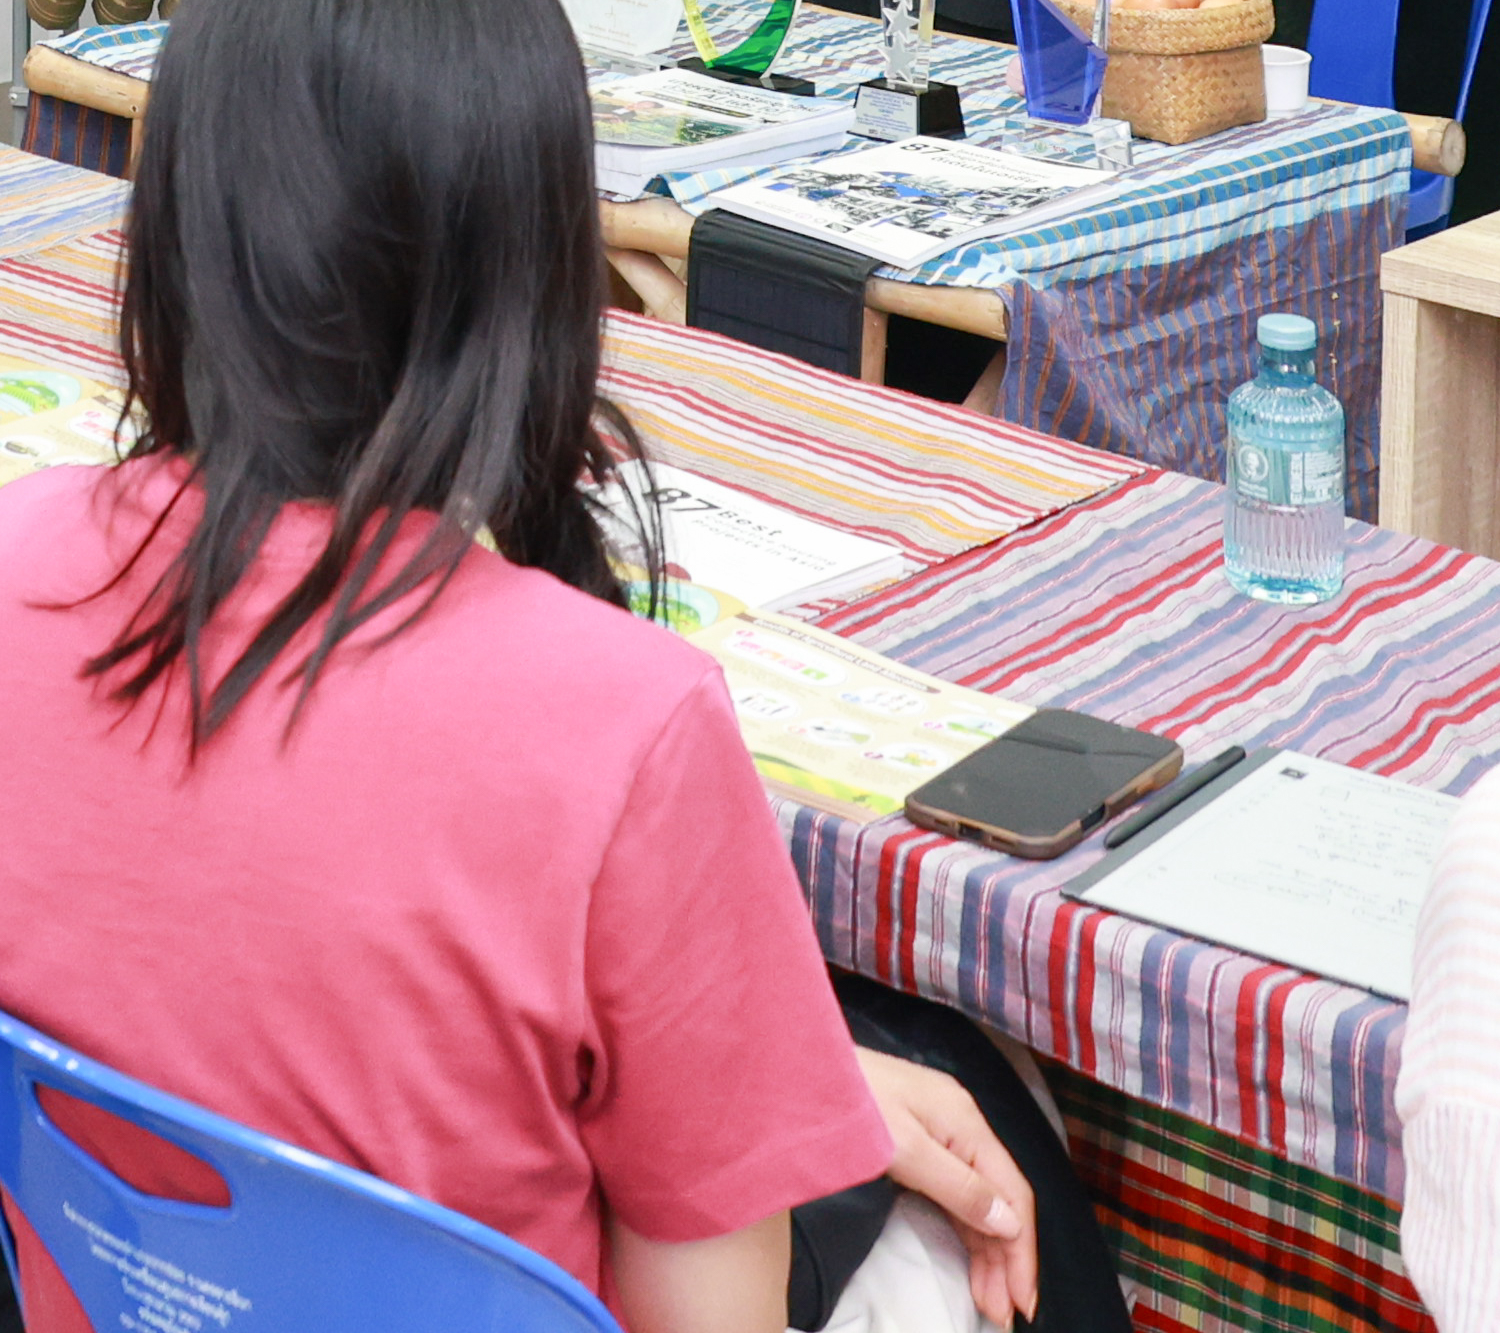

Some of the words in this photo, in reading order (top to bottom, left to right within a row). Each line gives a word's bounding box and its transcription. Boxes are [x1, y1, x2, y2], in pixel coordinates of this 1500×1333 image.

[900, 143, 950, 154] 87
[643, 488, 721, 512] 87
[718, 511, 783, 536] Best
